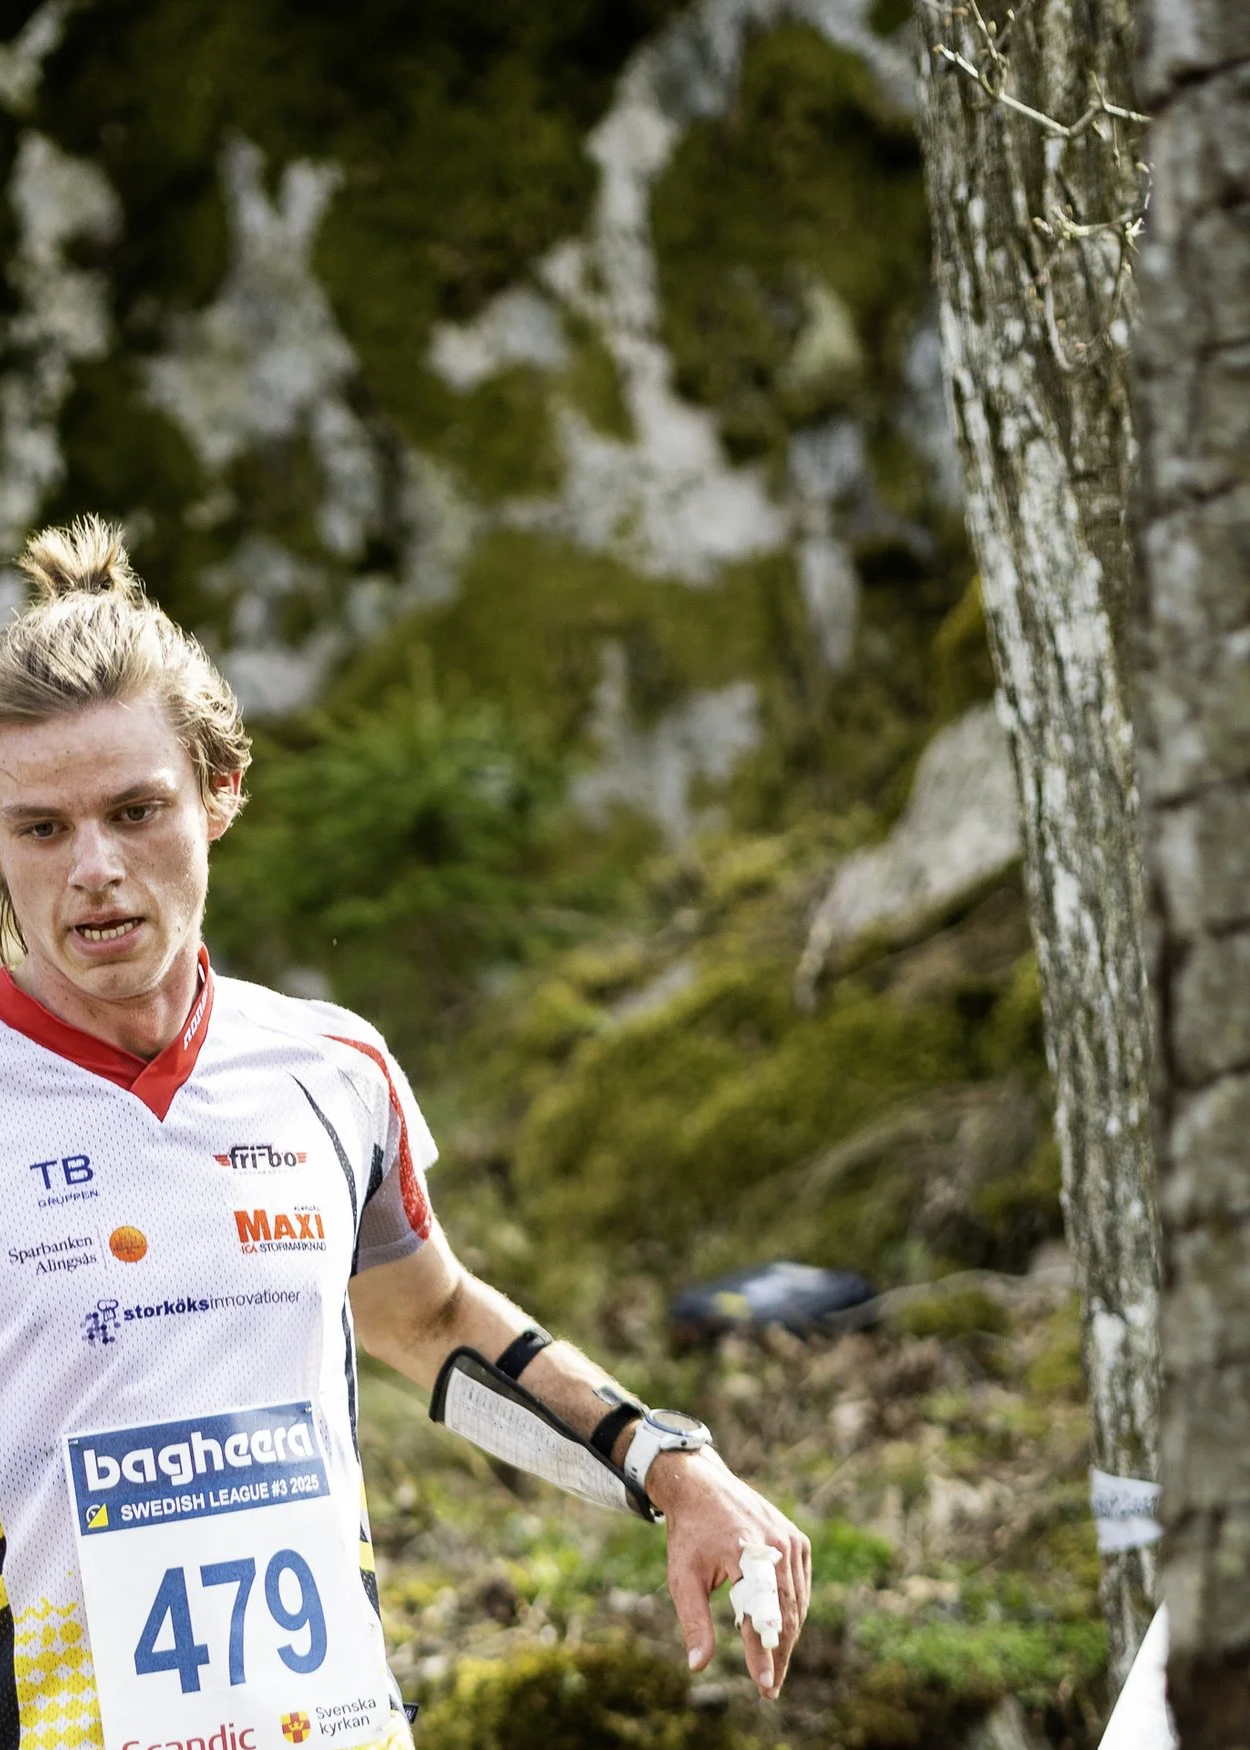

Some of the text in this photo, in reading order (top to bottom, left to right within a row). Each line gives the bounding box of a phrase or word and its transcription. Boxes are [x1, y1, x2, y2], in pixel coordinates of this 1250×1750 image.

[30, 1155, 94, 1190] TB
[38, 1190, 100, 1209] GRUPPEN
[234, 1209, 325, 1243] MAXI
[8, 1236, 93, 1264] Sparbanken
[241, 1241, 327, 1255] ICA STORMARKNAD
[36, 1253, 97, 1275] Alingsås
[123, 1290, 302, 1322] storköksinnovationer
[83, 1423, 314, 1492] bagheera
[120, 1474, 320, 1521] SWEDISH LEAGUE #3 2025
[133, 1548, 328, 1695] 479
[315, 1698, 377, 1720] Svenska
[318, 1714, 371, 1737] kyrkan
